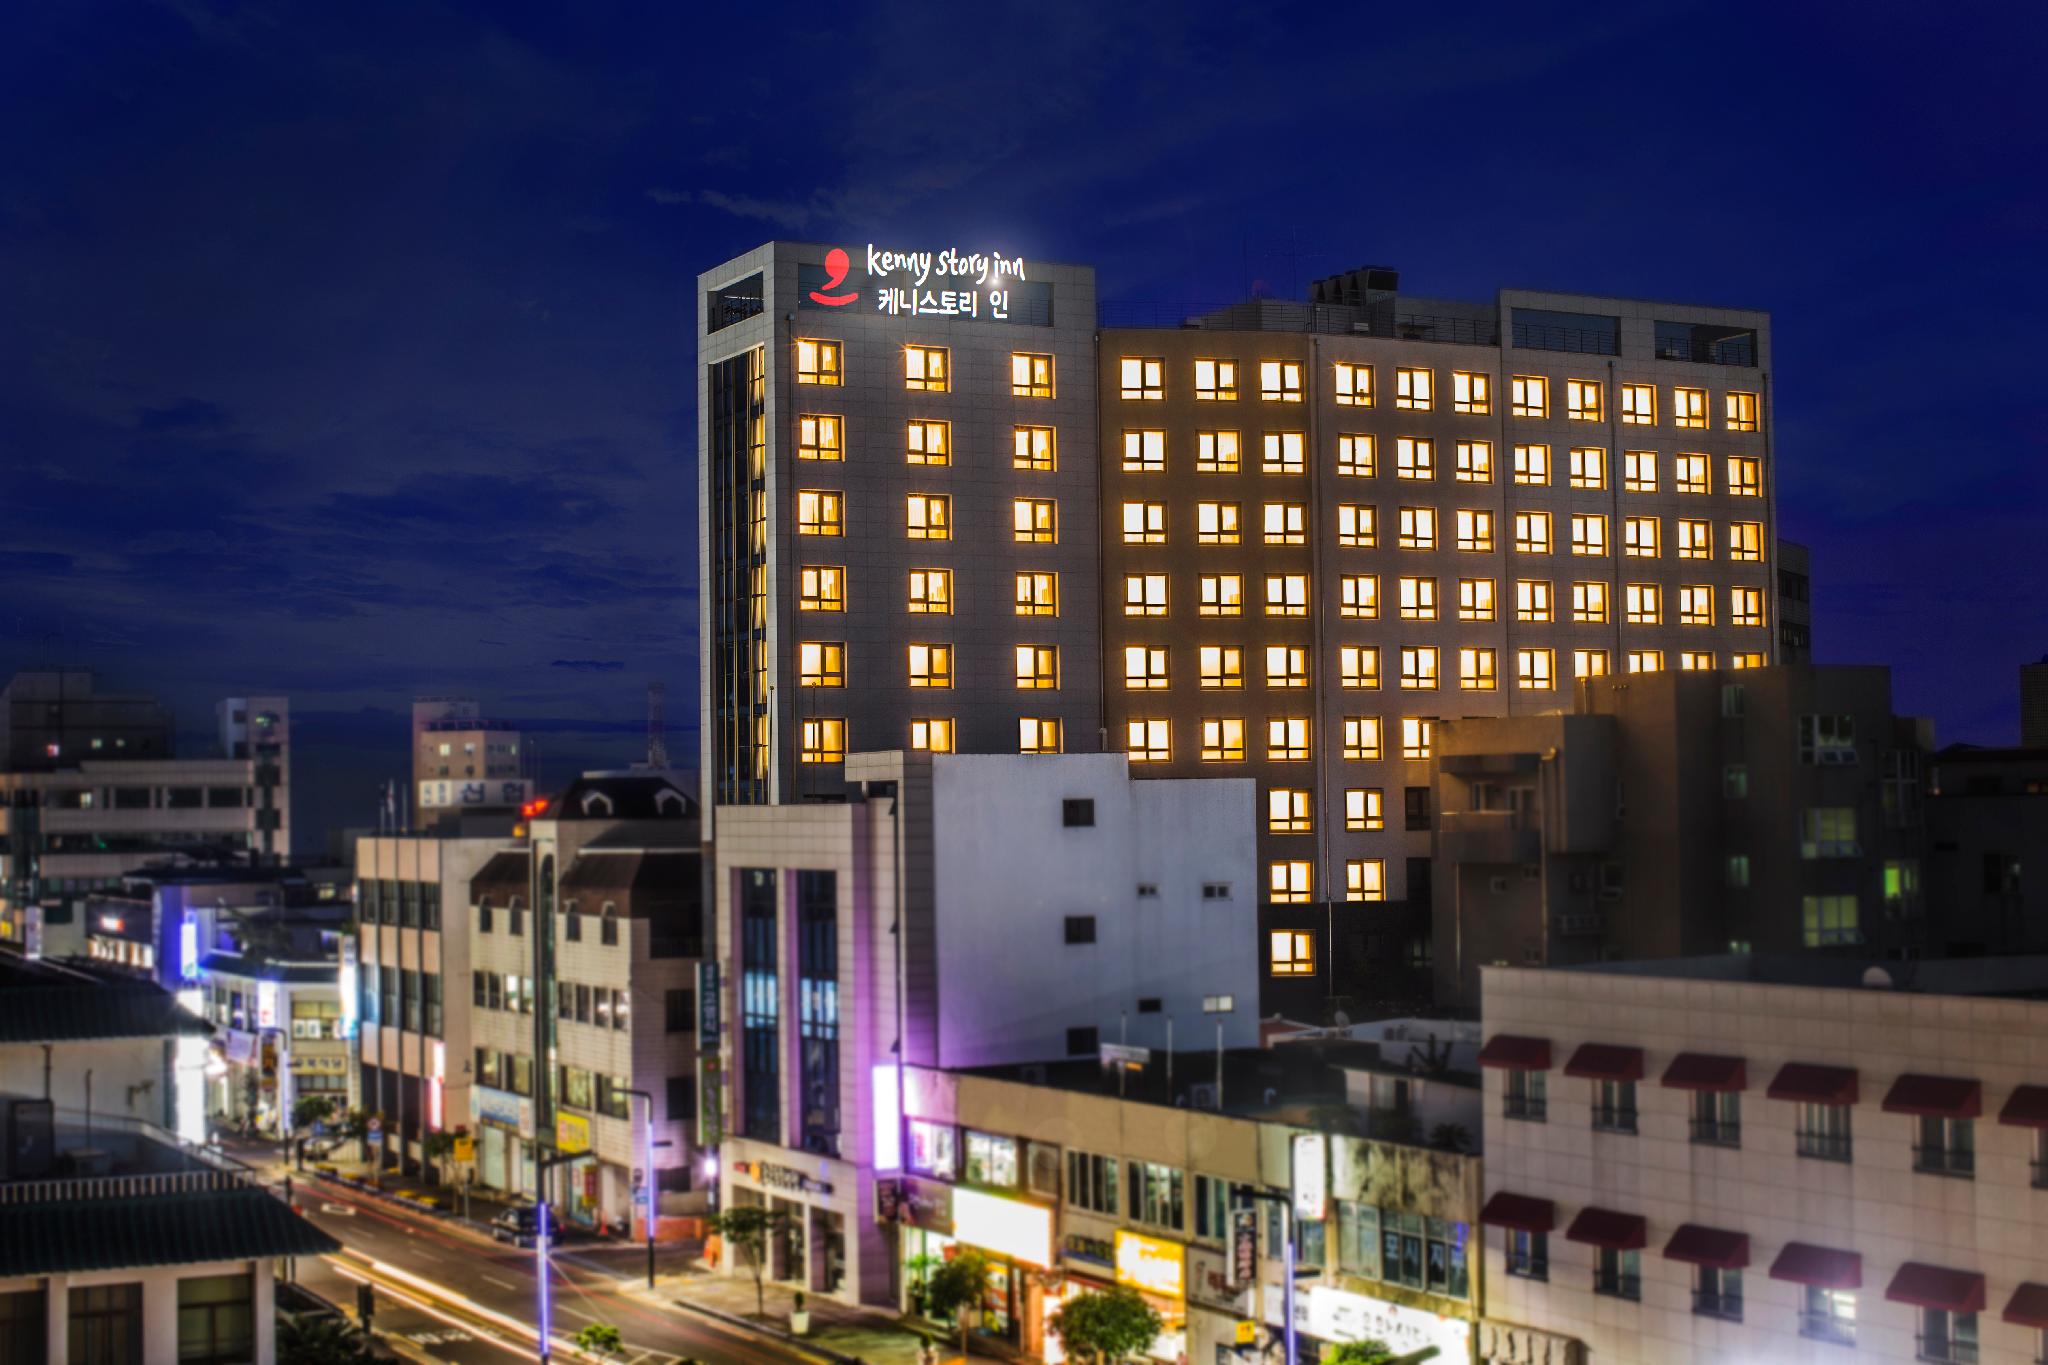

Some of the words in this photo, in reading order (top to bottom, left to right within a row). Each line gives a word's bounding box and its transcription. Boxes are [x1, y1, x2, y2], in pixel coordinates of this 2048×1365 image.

[867, 243, 931, 286] kenny
[993, 252, 1026, 281] inn
[878, 288, 977, 317] 케니스토리
[990, 290, 1008, 318] 인
